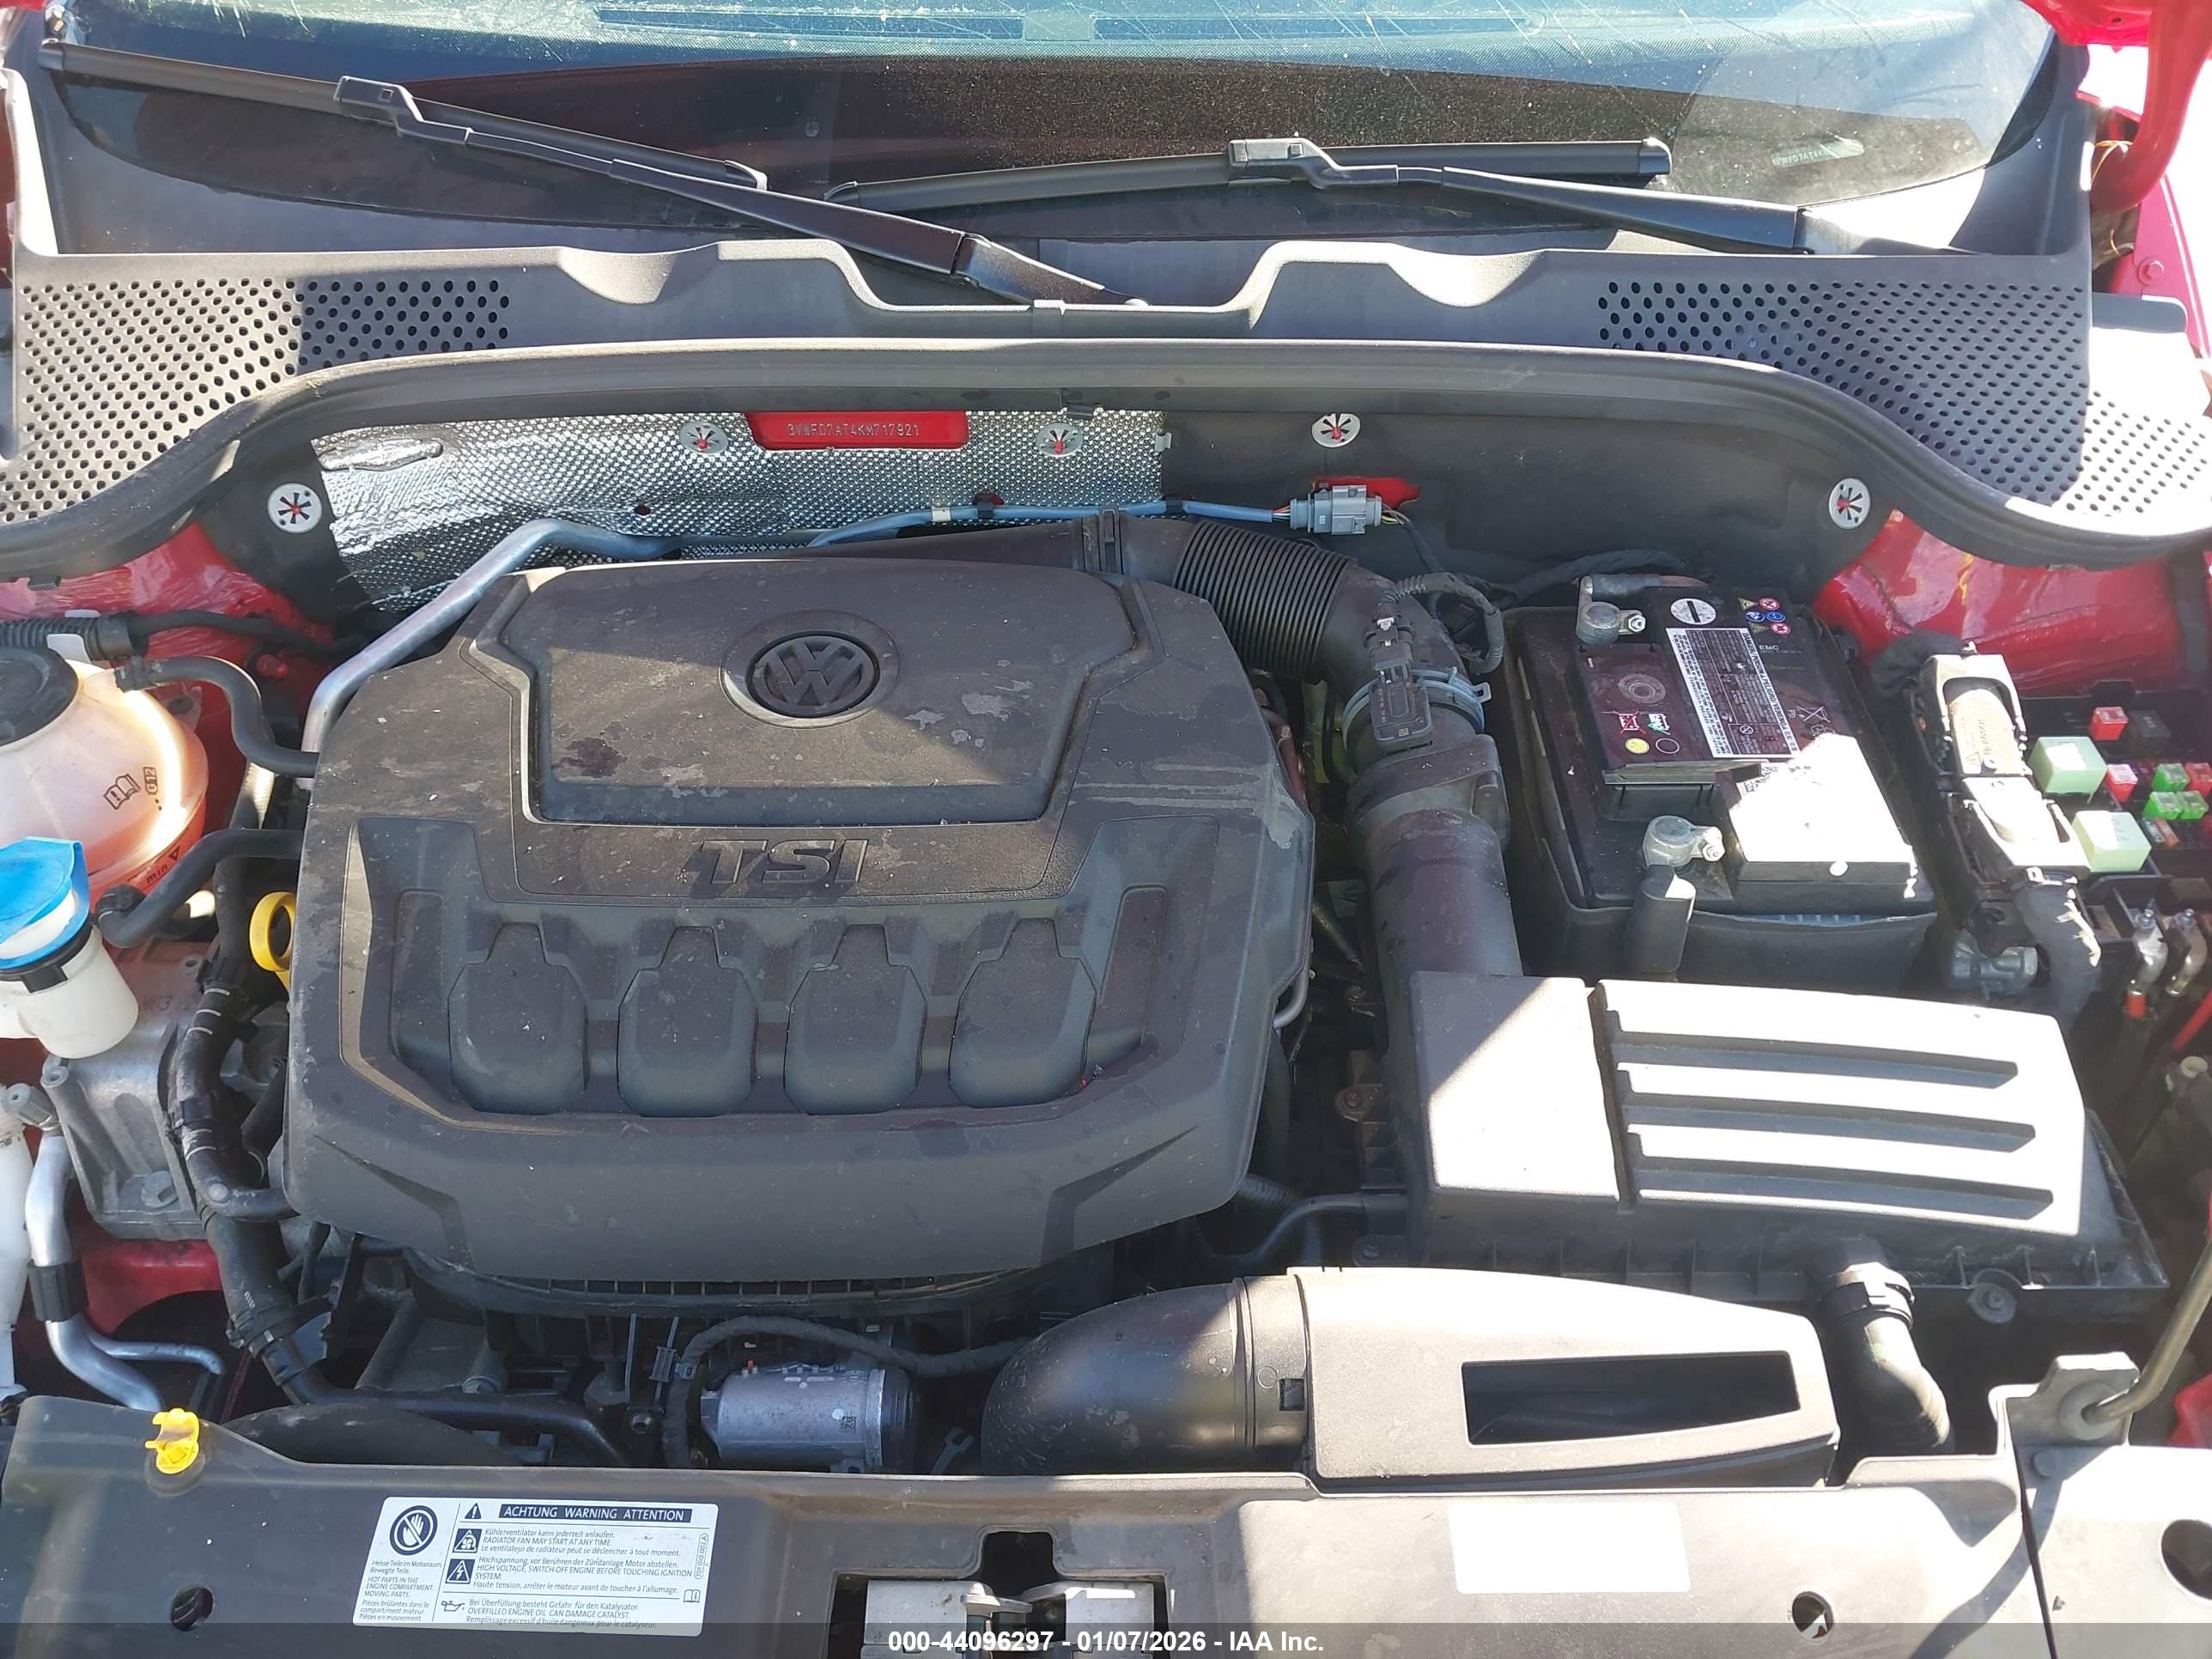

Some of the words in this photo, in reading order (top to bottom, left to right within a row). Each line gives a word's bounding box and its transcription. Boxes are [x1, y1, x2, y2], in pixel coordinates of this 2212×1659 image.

[701, 839, 869, 884] TSI
[146, 864, 168, 884] min
[503, 1506, 558, 1518] ACHTUNG
[564, 1507, 618, 1519] WARNING
[623, 1509, 684, 1521] ATTENTION
[466, 1616, 508, 1626] Remplissage
[507, 1616, 536, 1625] excessif
